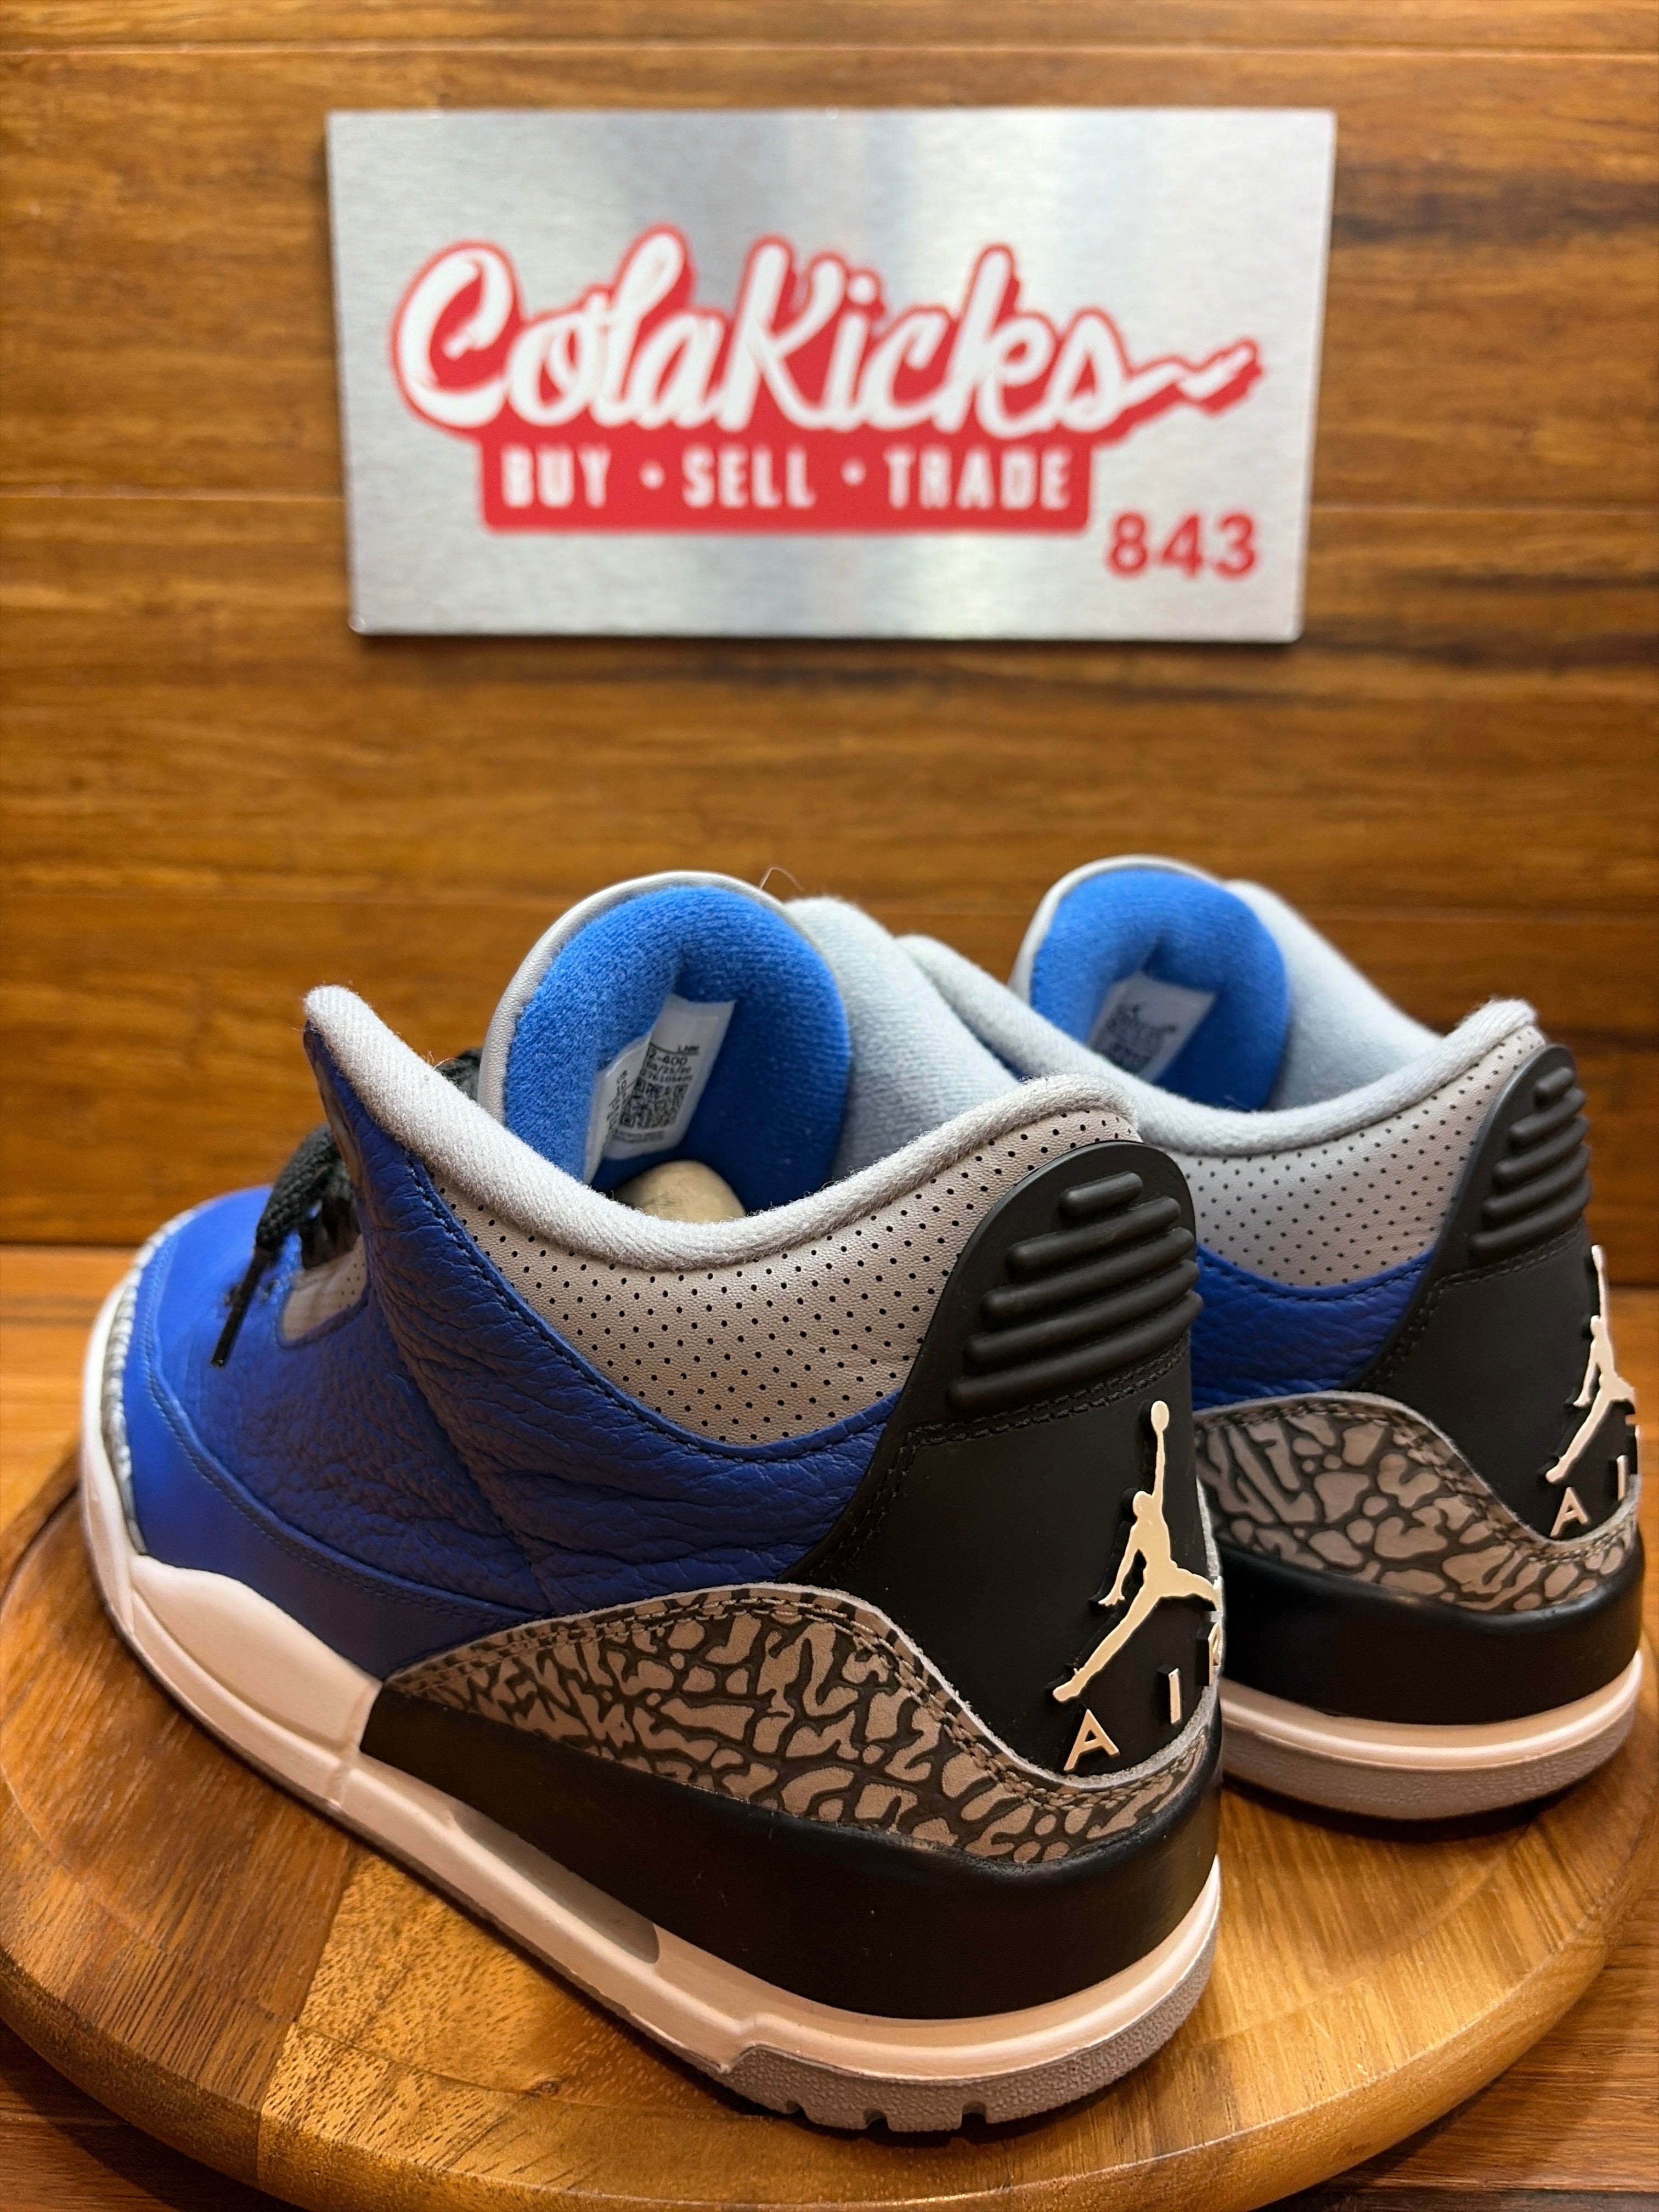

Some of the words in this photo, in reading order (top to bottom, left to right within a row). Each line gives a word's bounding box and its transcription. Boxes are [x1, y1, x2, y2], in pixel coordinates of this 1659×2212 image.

[500, 445, 611, 509] BUY
[680, 444, 816, 510] SELL
[884, 445, 1073, 511] TRADE
[1106, 511, 1259, 580] 843
